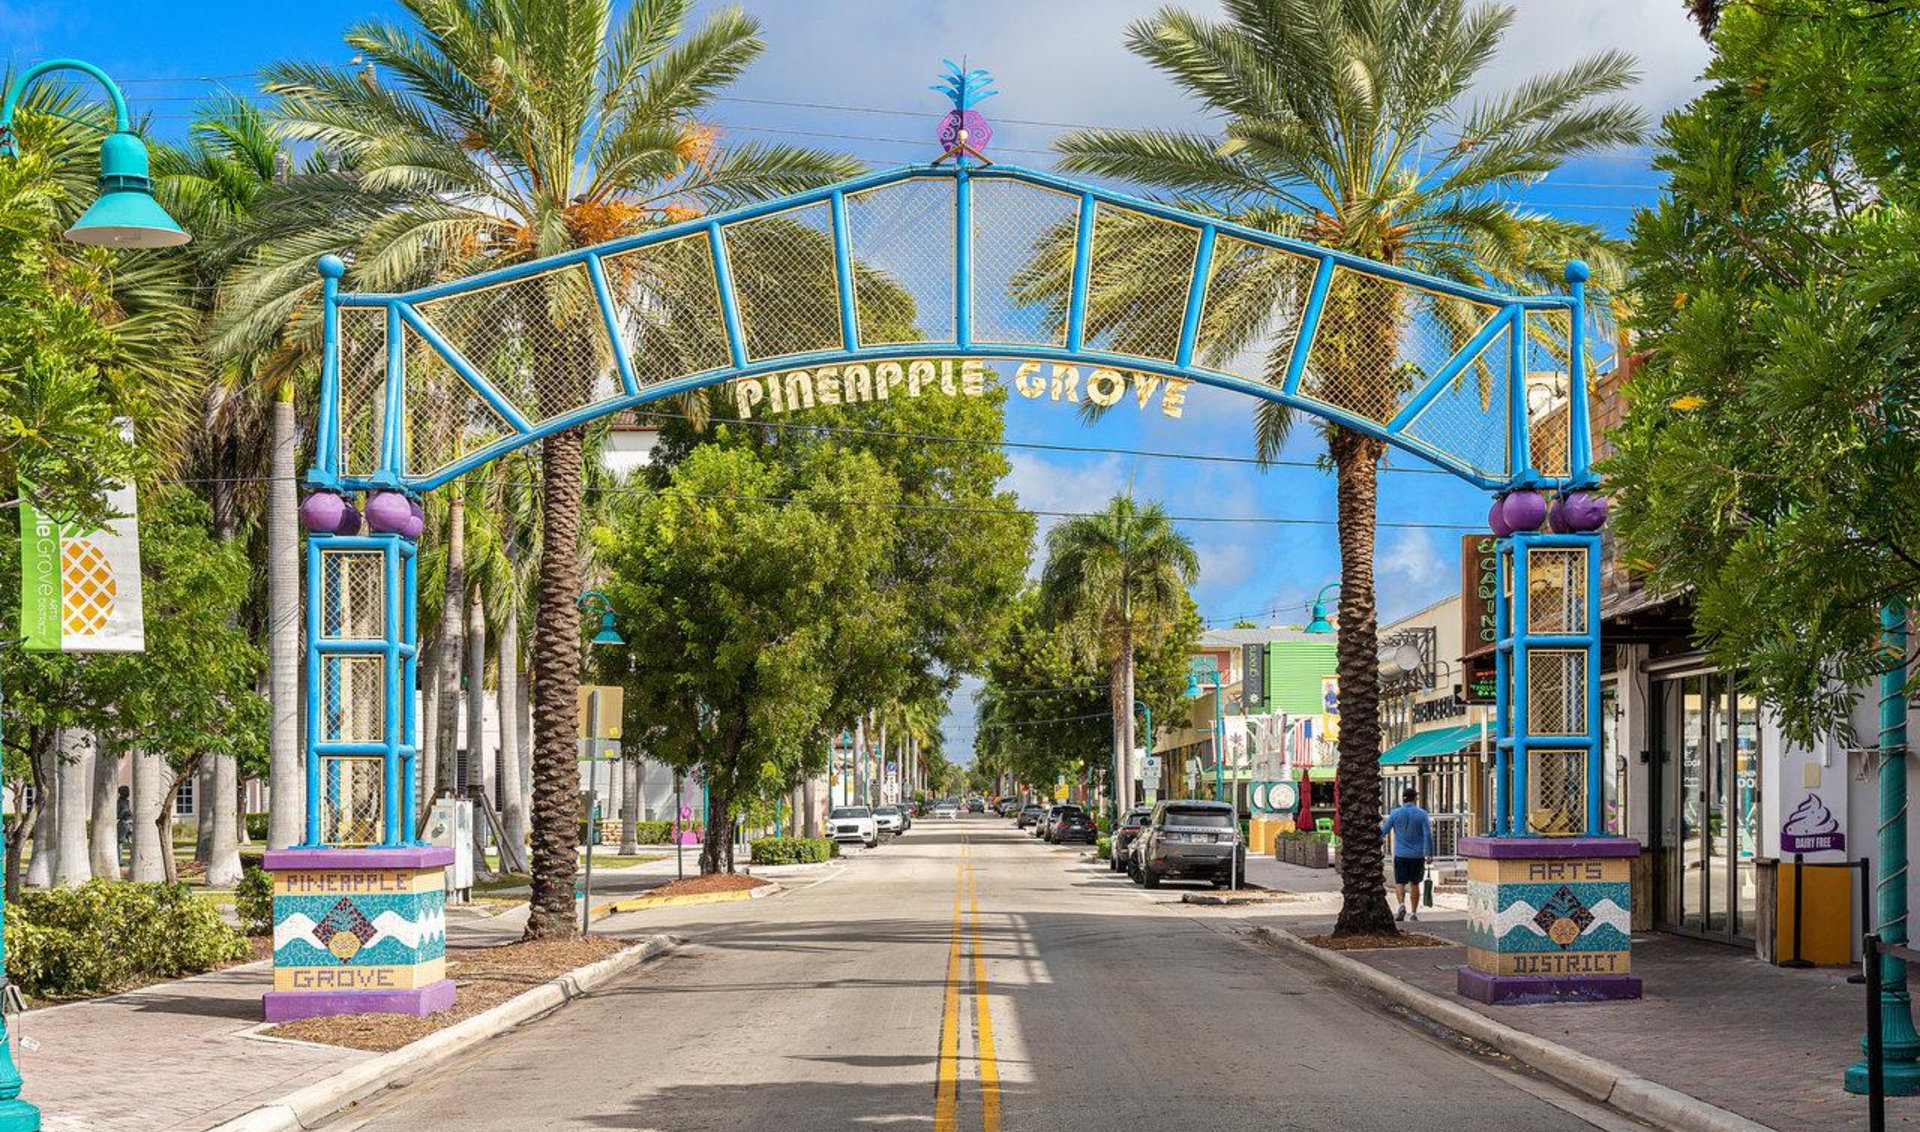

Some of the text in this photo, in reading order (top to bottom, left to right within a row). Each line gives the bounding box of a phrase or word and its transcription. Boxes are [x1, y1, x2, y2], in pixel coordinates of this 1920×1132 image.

[735, 359, 1189, 419] PINEAPPLE GROVE
[1795, 836, 1831, 849] DAIRY FREE
[1529, 862, 1602, 880] ARTS
[287, 874, 407, 892] PINEAPPLE
[1513, 954, 1617, 973] DISTRICT
[293, 969, 394, 988] GROVE
